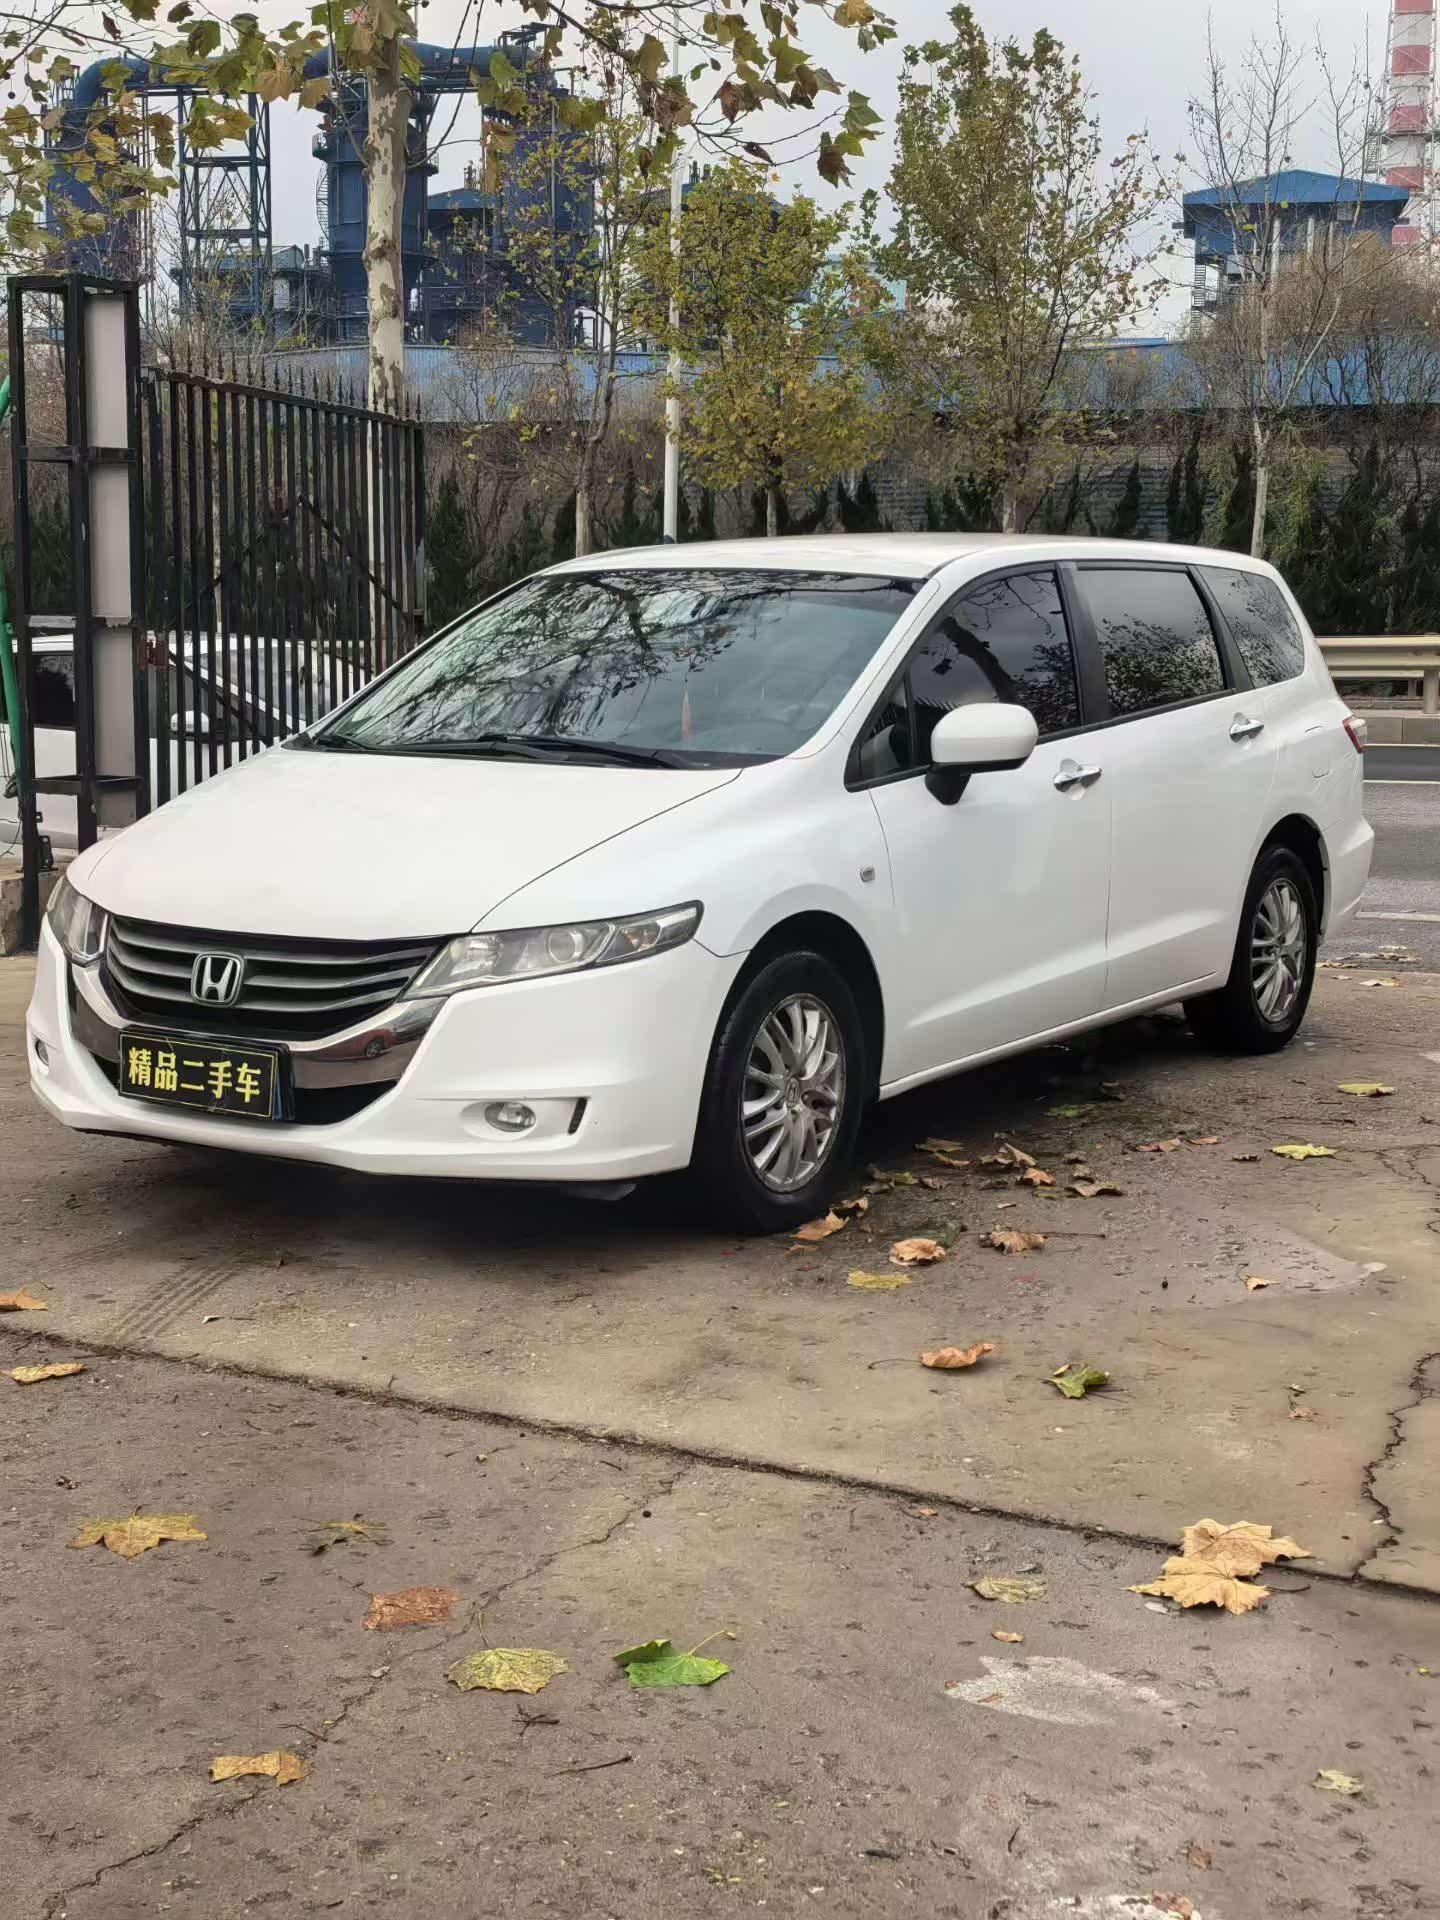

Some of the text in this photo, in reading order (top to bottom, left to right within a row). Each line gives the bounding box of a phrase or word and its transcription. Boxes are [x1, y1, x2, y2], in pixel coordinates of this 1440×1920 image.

[128, 1046, 262, 1103] 精品二手车
